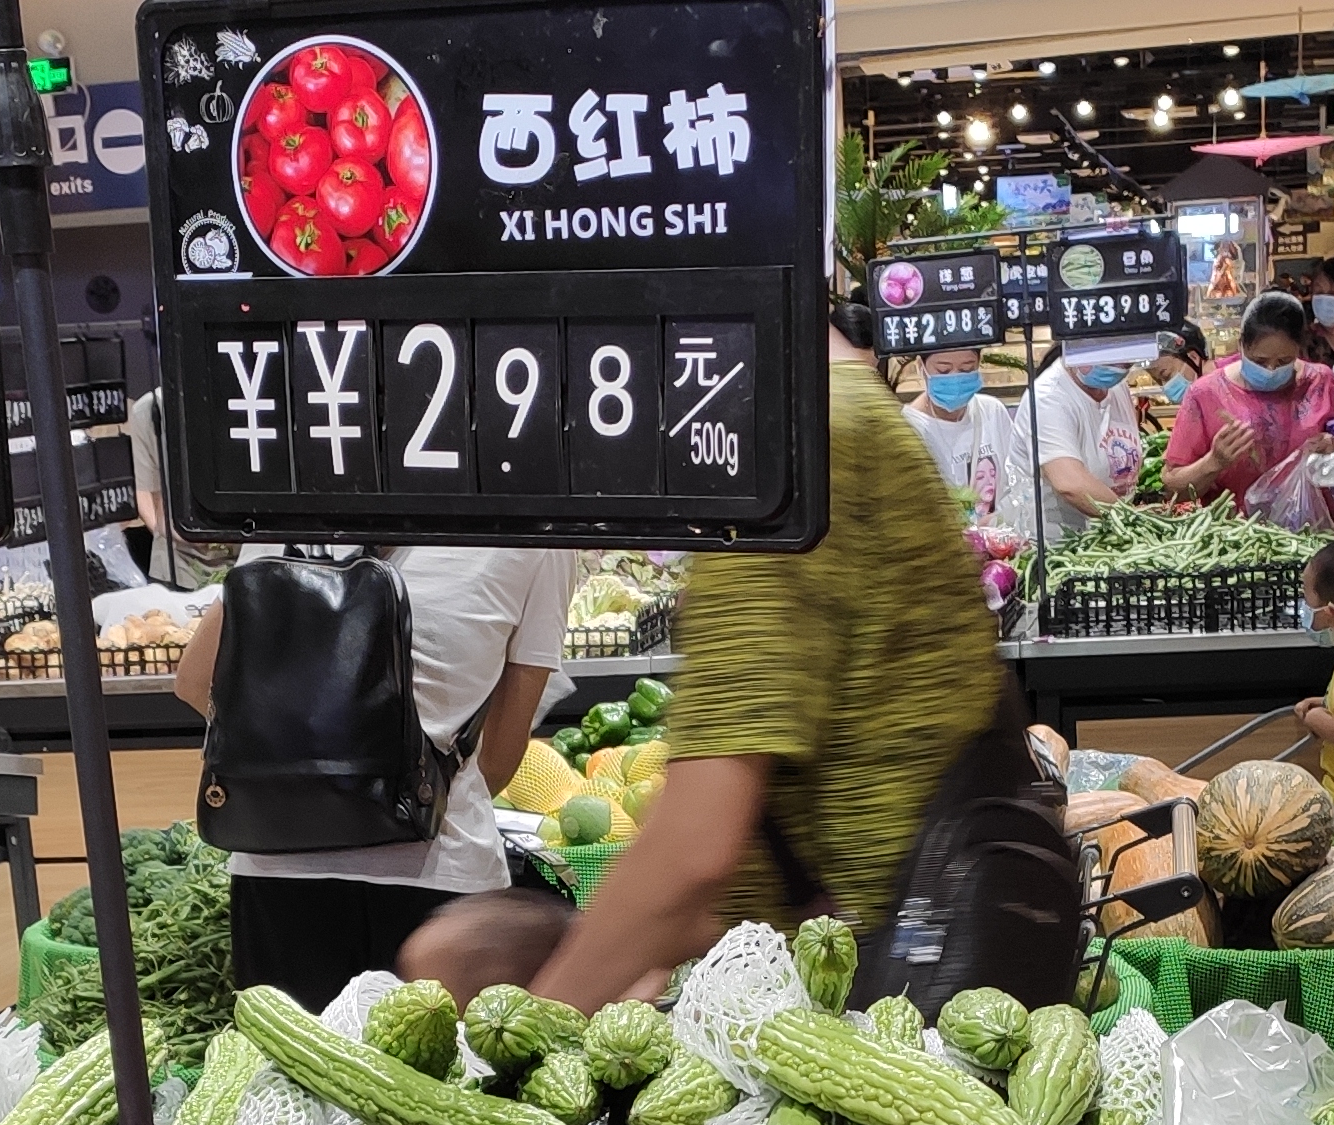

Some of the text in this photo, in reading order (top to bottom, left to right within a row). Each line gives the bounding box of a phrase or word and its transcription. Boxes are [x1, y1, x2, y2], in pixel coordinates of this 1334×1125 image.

[478, 82, 752, 187] 西红柿
[50, 176, 94, 196] exits
[499, 202, 729, 242] XI HONG SHI
[938, 266, 975, 284] 洋葱
